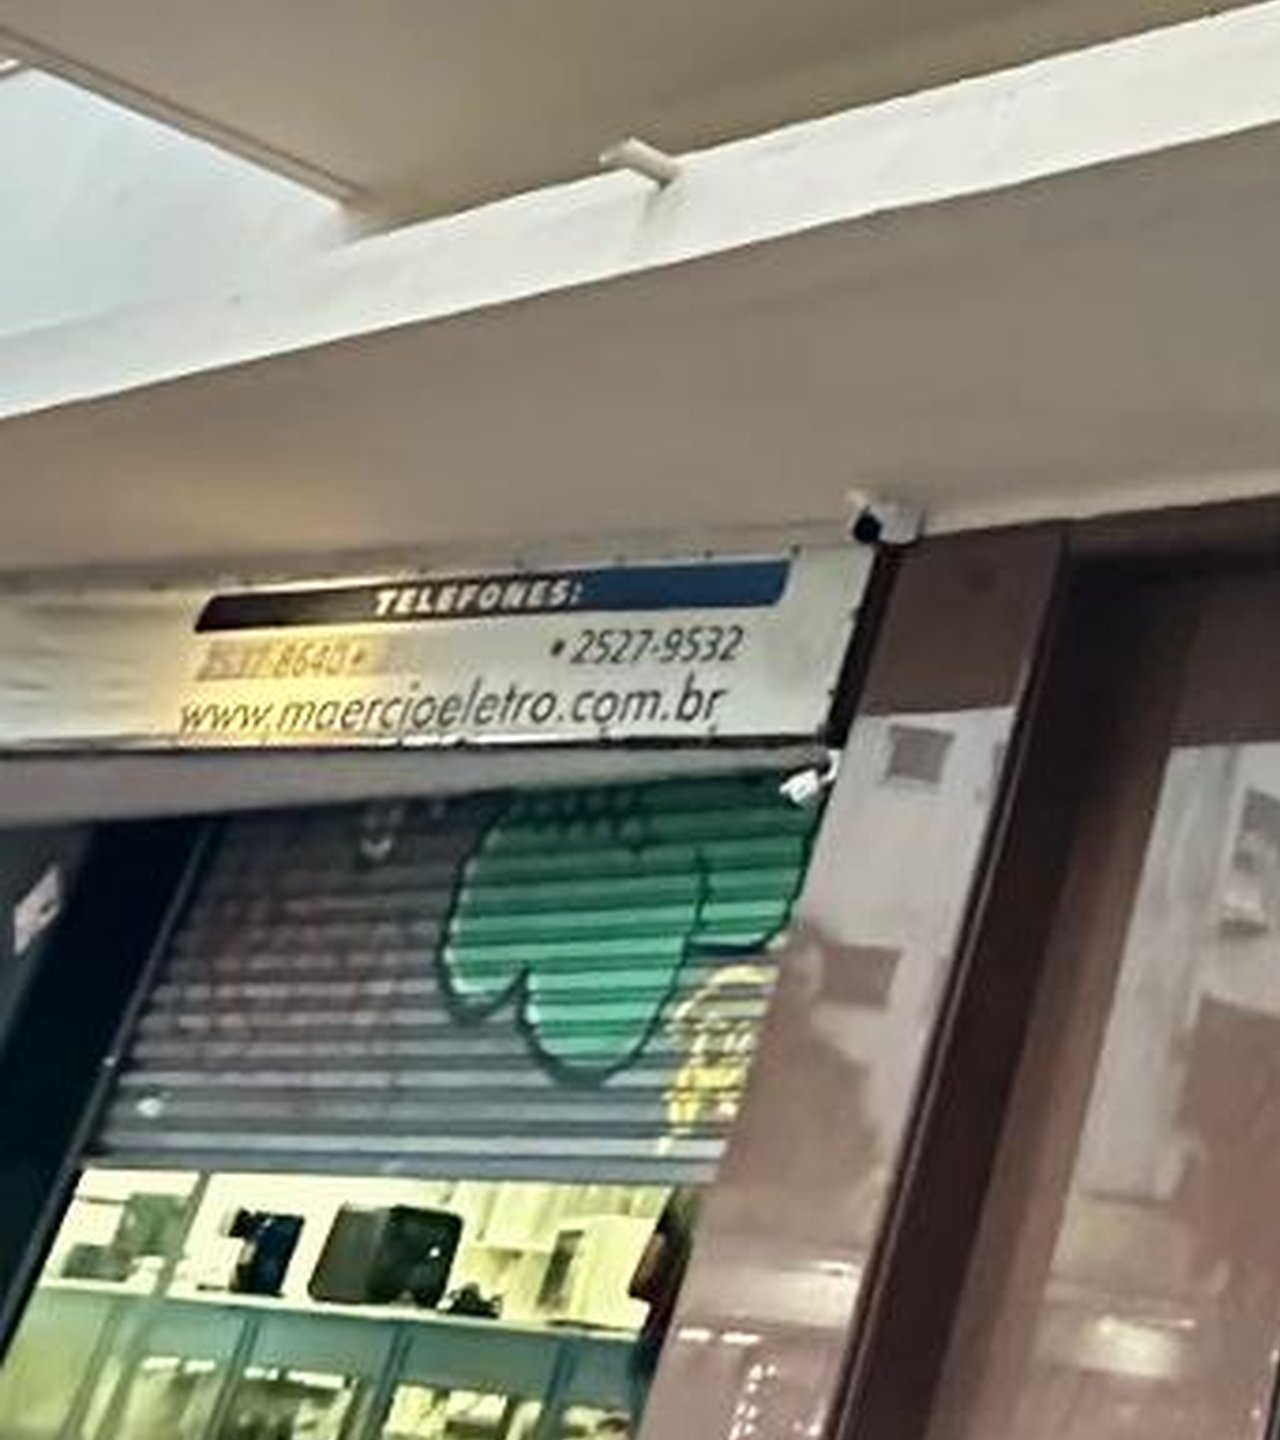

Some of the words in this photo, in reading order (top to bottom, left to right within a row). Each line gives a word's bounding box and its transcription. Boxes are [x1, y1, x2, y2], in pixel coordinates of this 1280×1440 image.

[374, 577, 583, 616] TELEFONES:
[569, 624, 744, 665] 2527-9532
[181, 670, 729, 734] www.maercioeletro.com.br
